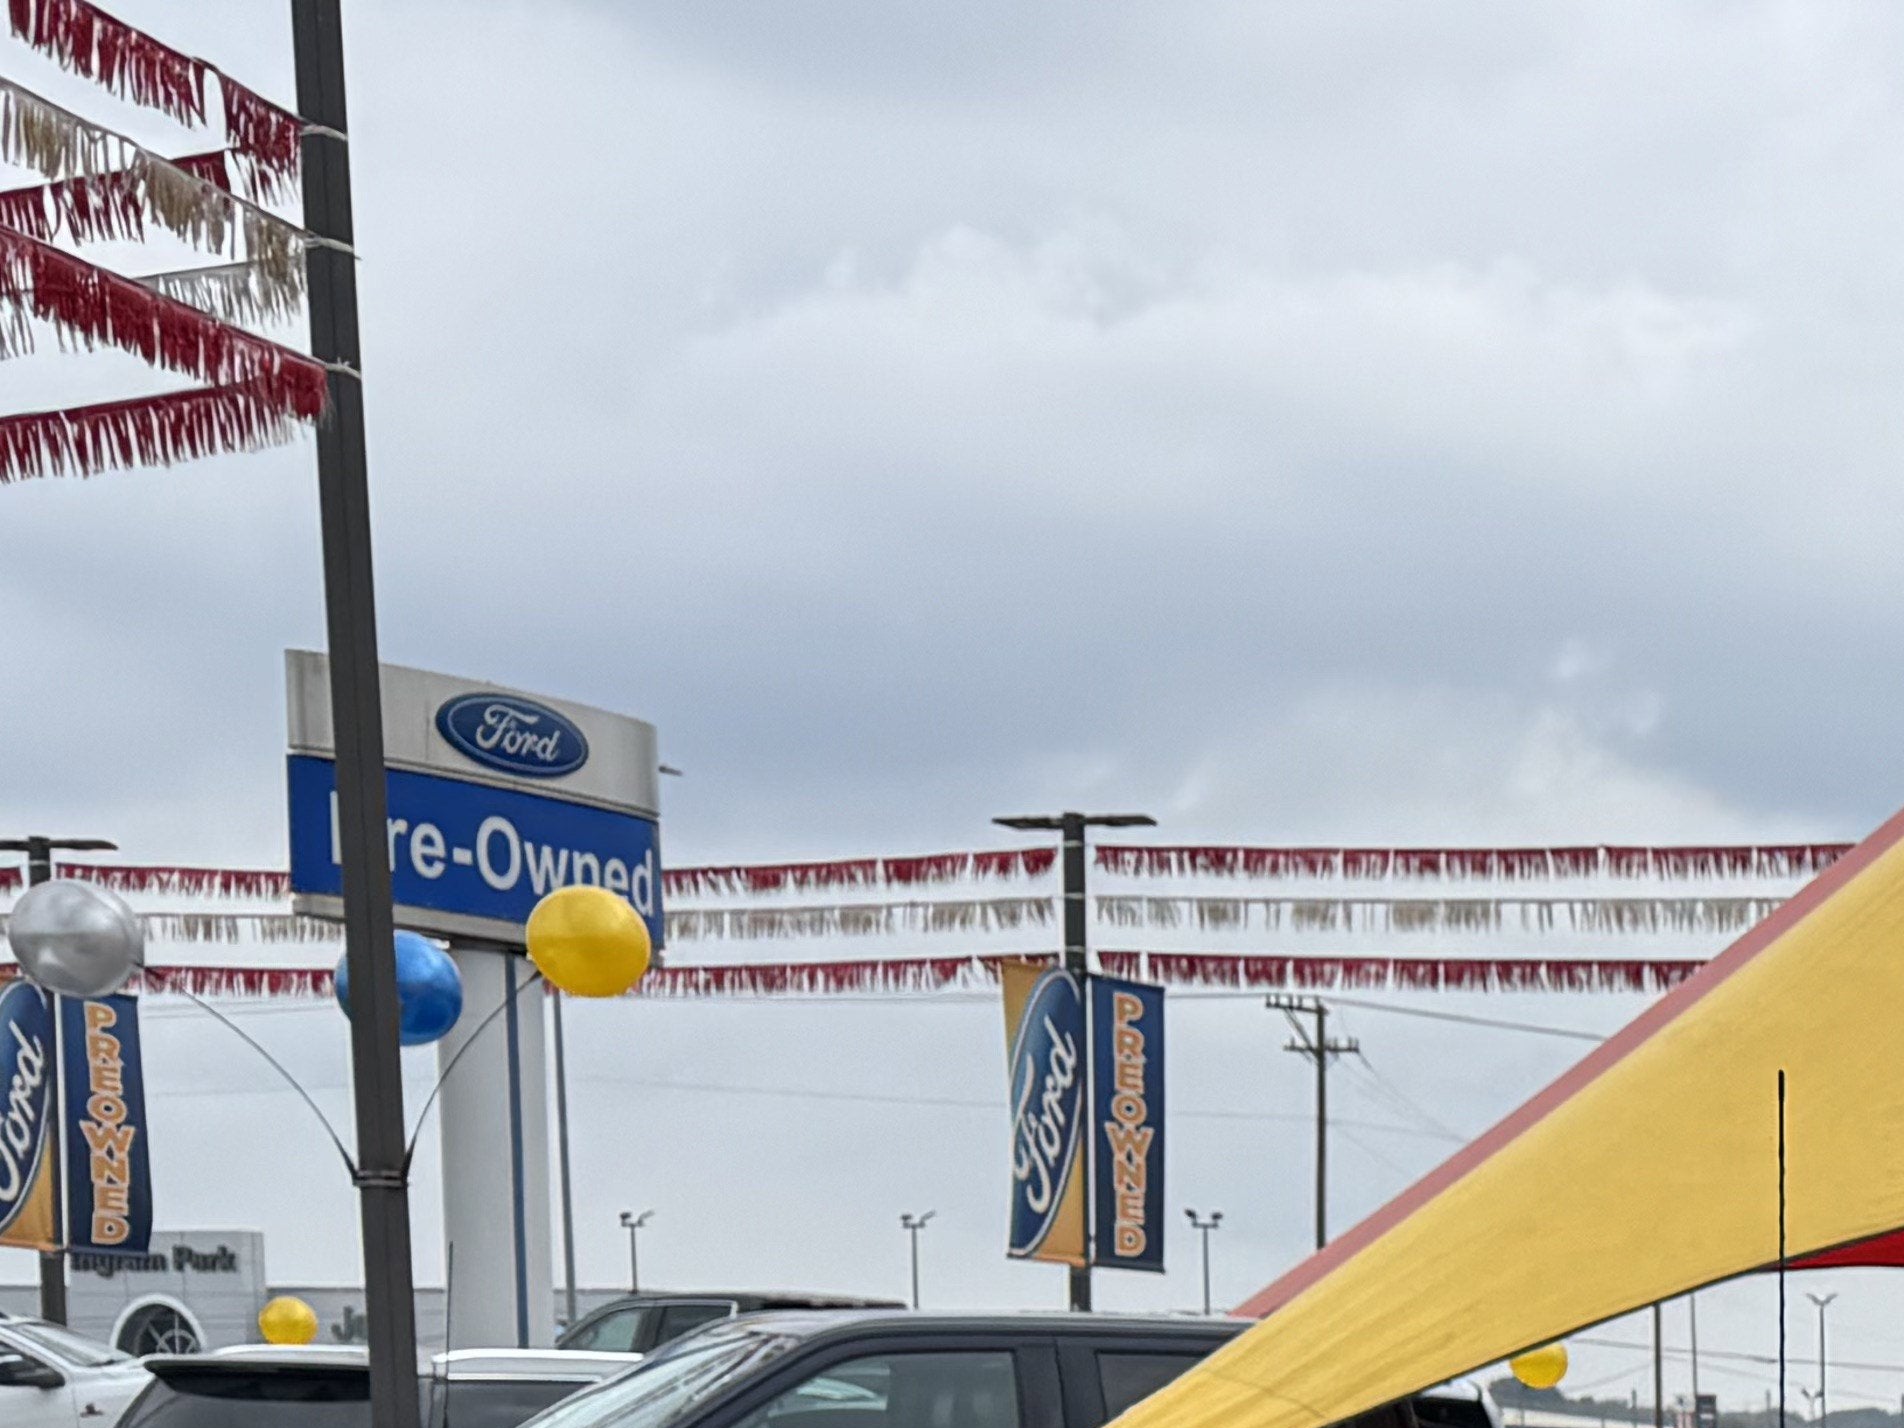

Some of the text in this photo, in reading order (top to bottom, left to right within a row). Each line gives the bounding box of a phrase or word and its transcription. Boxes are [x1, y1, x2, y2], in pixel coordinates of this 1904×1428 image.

[475, 704, 561, 761] Ford
[79, 1001, 136, 1244] PREOWNED
[1013, 1014, 1077, 1213] Ford
[1104, 992, 1154, 1257] PREOWNED
[172, 1244, 237, 1272] Park
